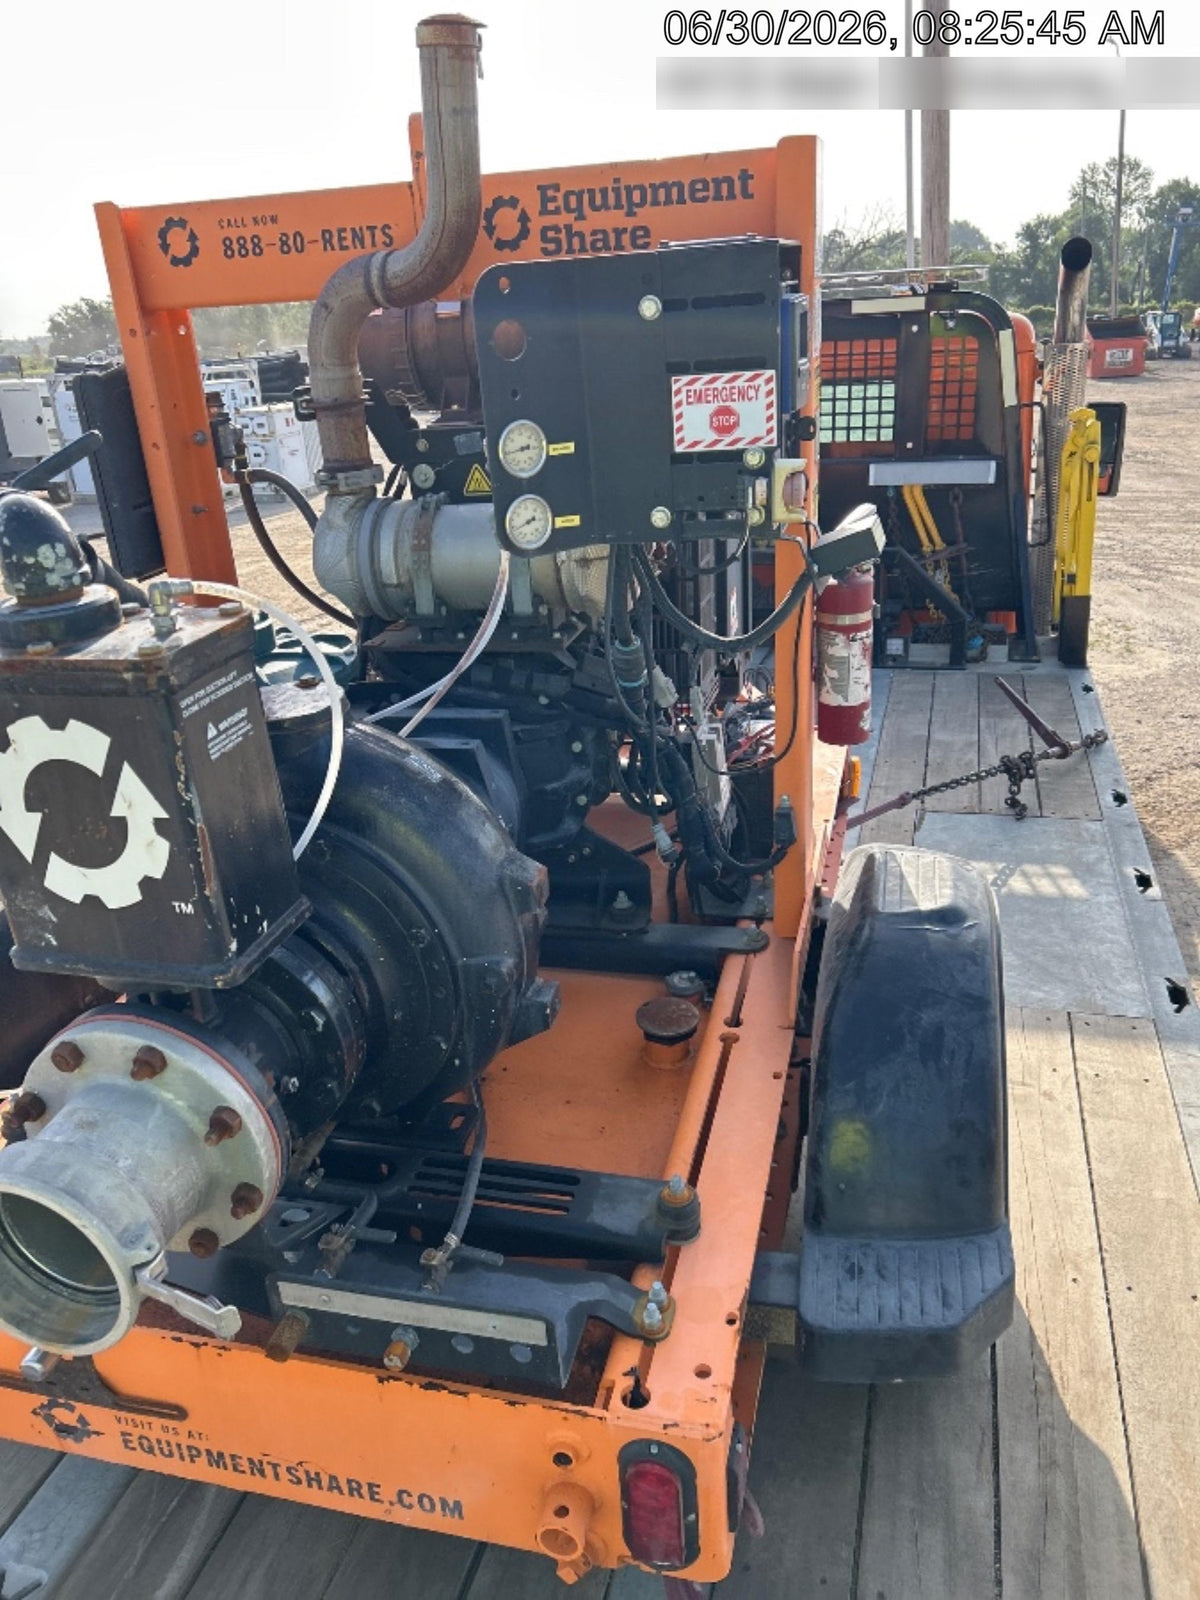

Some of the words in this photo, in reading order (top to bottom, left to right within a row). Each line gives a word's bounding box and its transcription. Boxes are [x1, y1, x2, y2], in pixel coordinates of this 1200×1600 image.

[537, 168, 755, 221] Equipment
[217, 217, 248, 230] CALL
[252, 214, 279, 227] NOW
[221, 223, 395, 260] 888-80-RENTS
[540, 223, 651, 257] Share
[685, 383, 761, 406] EMERGENCY
[712, 415, 737, 428] STOP
[171, 900, 195, 915] TM
[114, 1414, 154, 1431] VISIT
[161, 1424, 180, 1437] US
[187, 1429, 209, 1442] AT:
[120, 1430, 465, 1521] EQUIPMENTSHARE.COM
